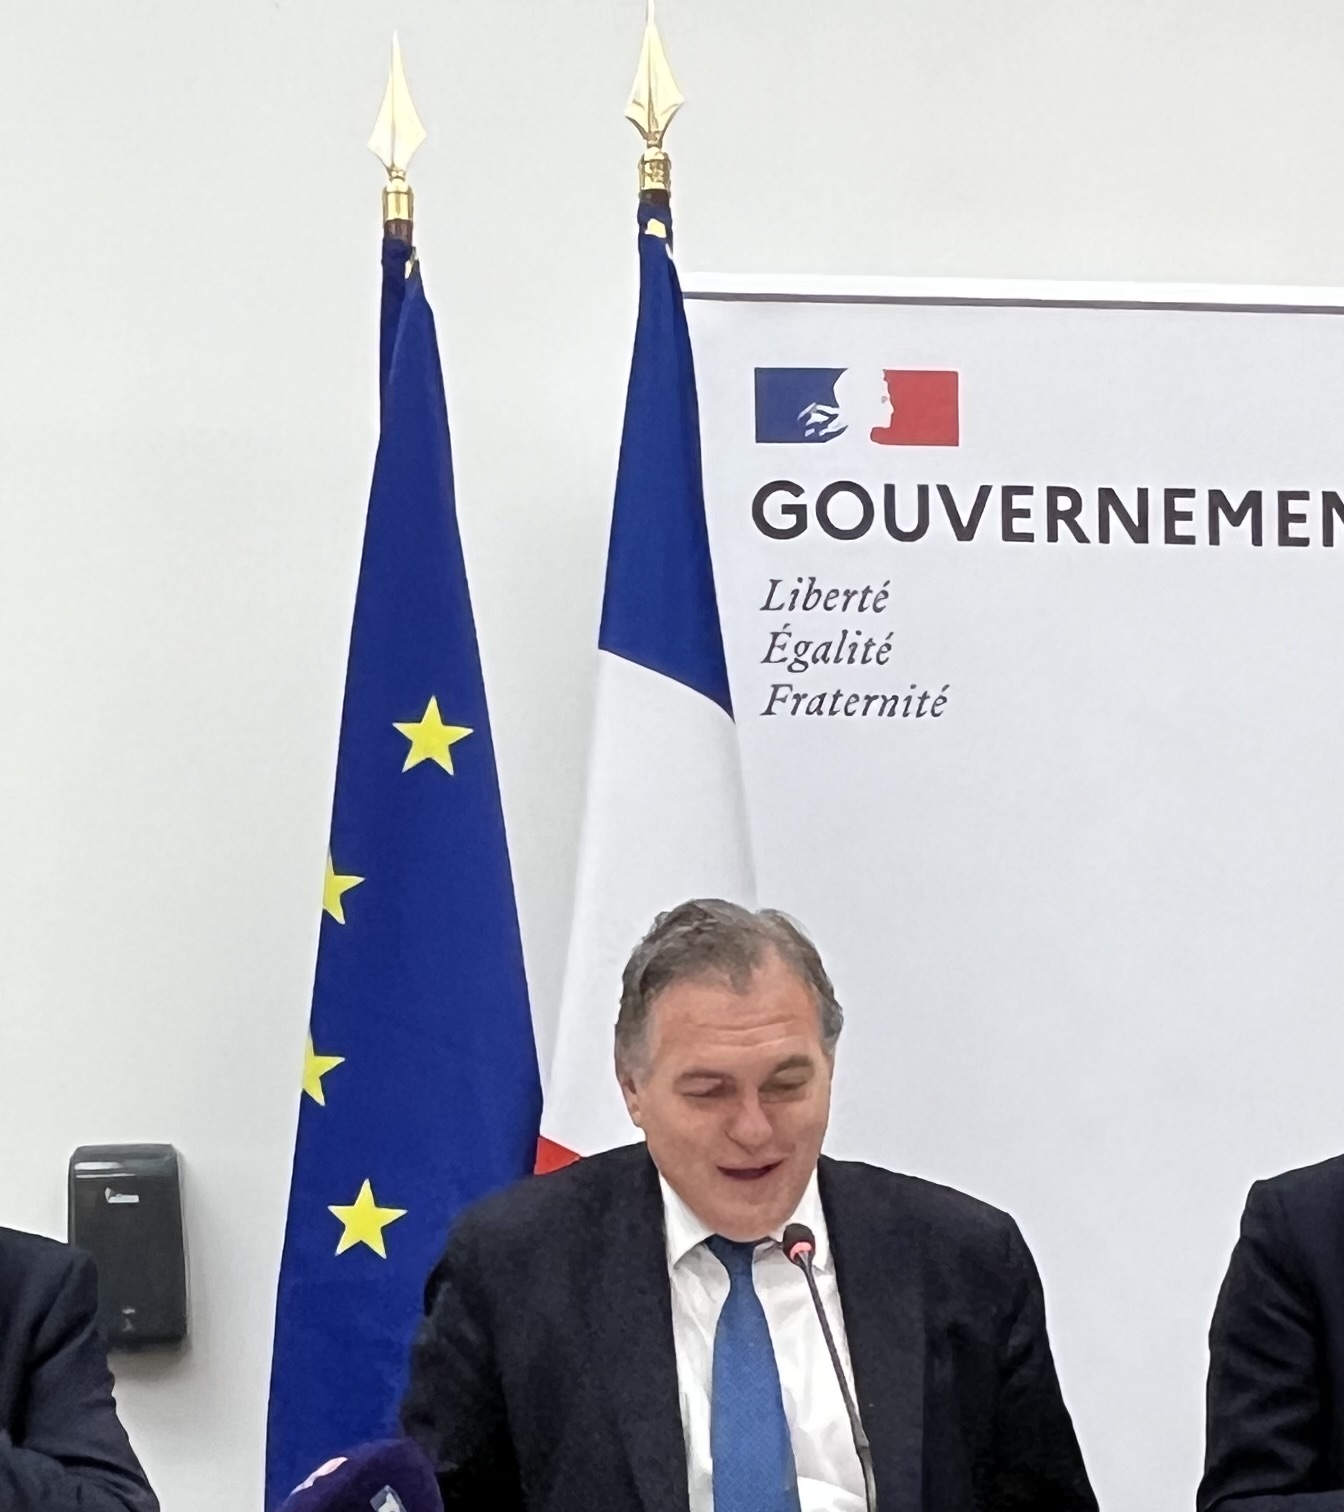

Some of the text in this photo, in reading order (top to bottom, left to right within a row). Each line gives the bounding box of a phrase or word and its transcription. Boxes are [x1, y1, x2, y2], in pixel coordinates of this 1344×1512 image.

[759, 576, 891, 614] Liberté
[759, 622, 894, 672] Égalité
[759, 683, 950, 719] Fraternité
